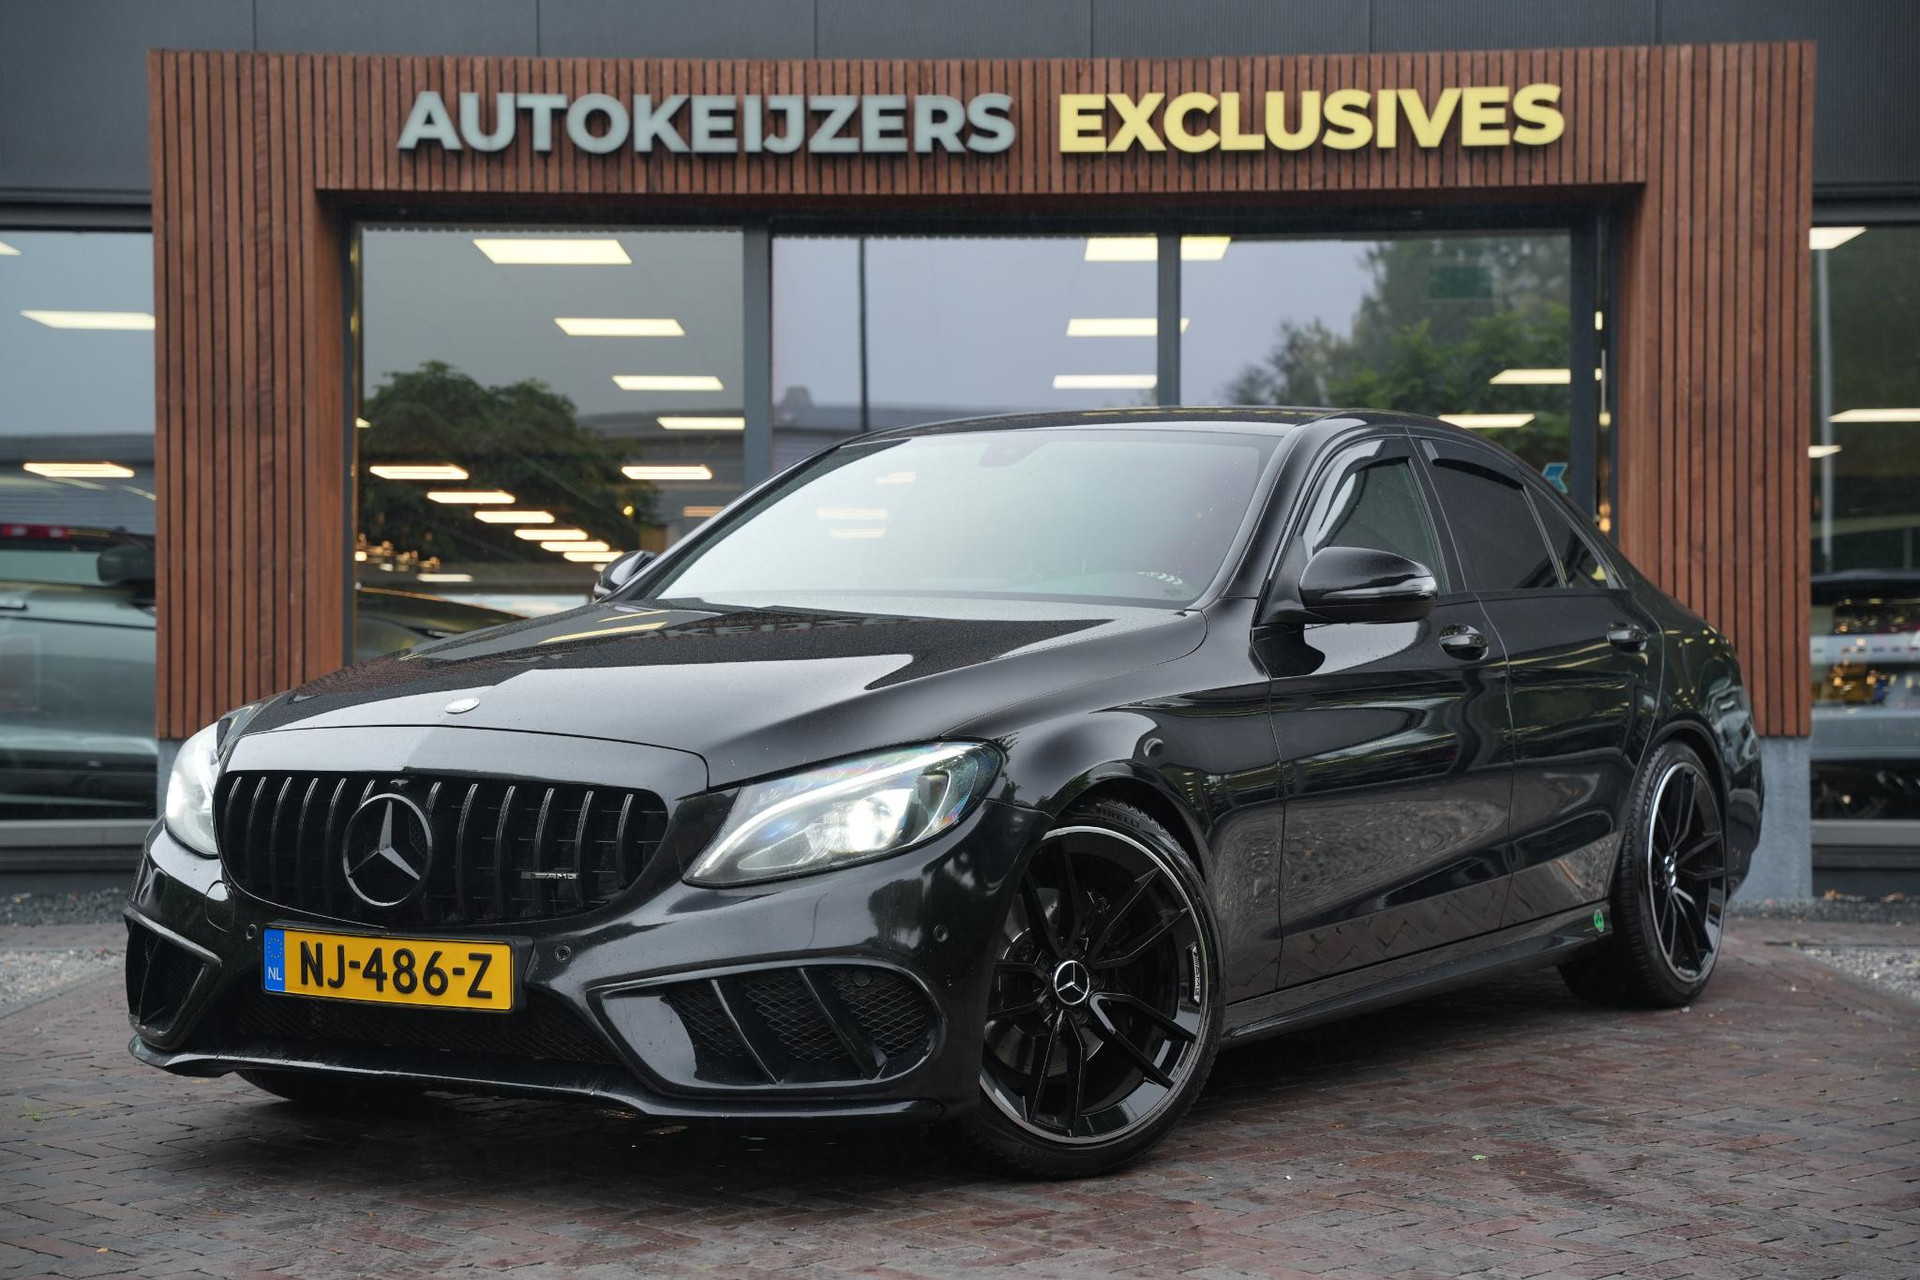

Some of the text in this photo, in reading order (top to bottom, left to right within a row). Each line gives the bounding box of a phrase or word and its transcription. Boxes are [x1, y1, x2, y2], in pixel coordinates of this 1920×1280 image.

[397, 83, 1566, 154] AUTOKEIJZERS EXCLUSIVES
[267, 966, 283, 982] NL
[300, 940, 493, 999] NJ-486-Z
